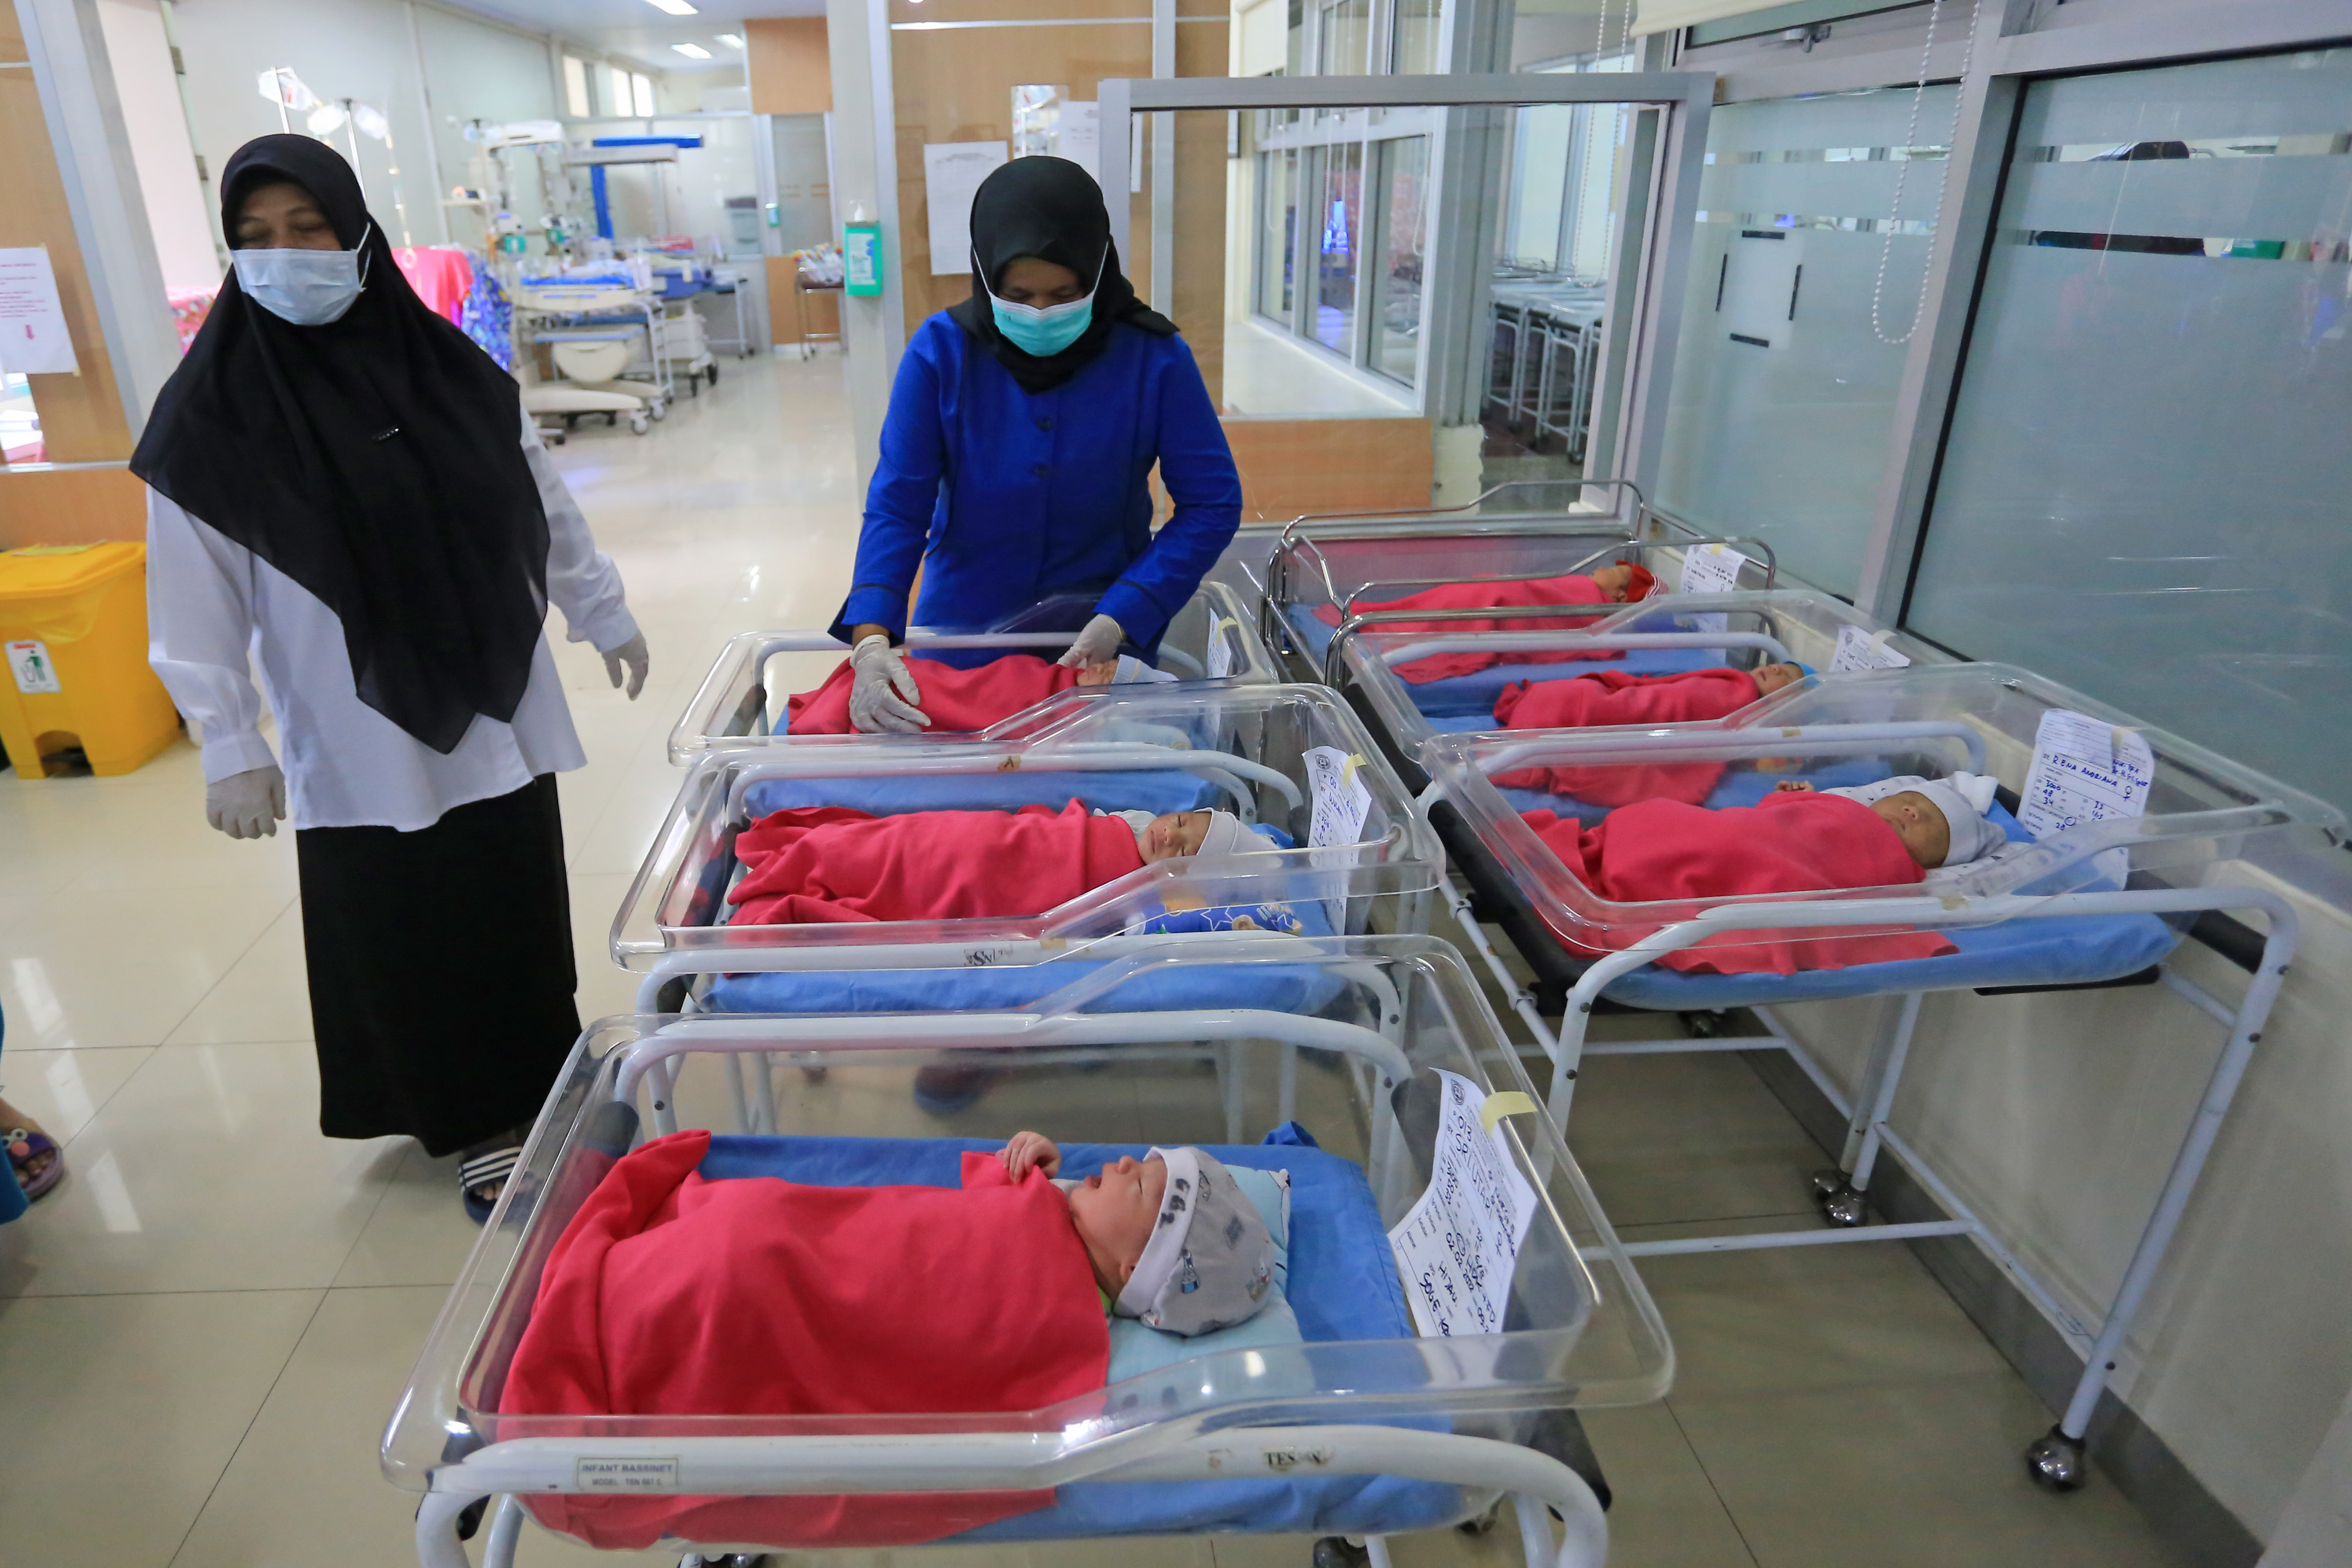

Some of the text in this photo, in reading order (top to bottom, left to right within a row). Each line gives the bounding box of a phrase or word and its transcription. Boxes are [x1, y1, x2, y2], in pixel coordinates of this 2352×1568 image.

[1458, 1115, 1473, 1142] 013
[582, 1464, 673, 1472] INFANT BASSINET
